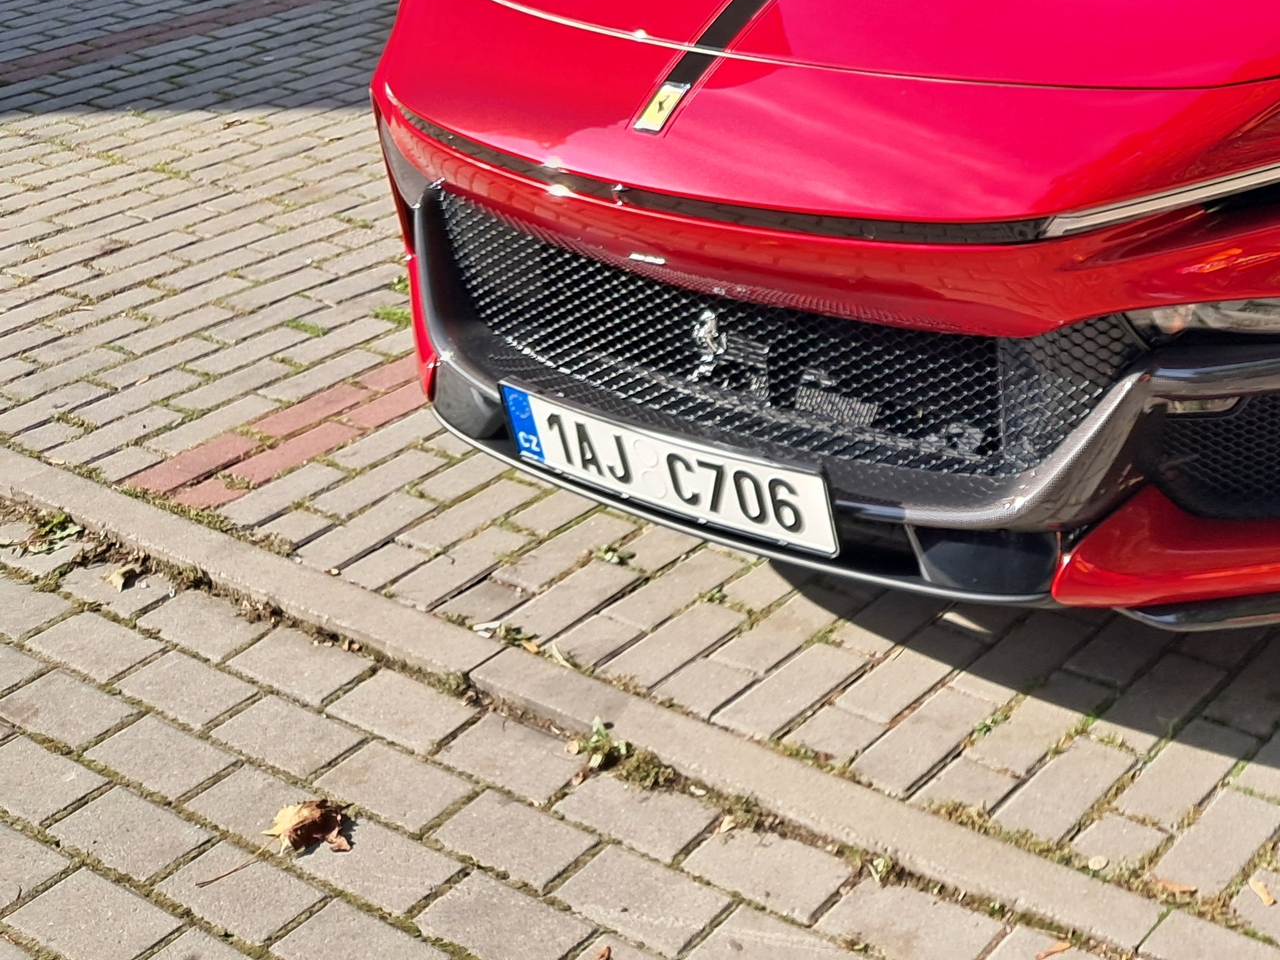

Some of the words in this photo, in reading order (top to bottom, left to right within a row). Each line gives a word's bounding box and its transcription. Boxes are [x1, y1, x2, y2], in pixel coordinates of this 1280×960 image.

[518, 431, 541, 452] CZ
[547, 413, 632, 484] 1AJ
[666, 453, 805, 533] C706
